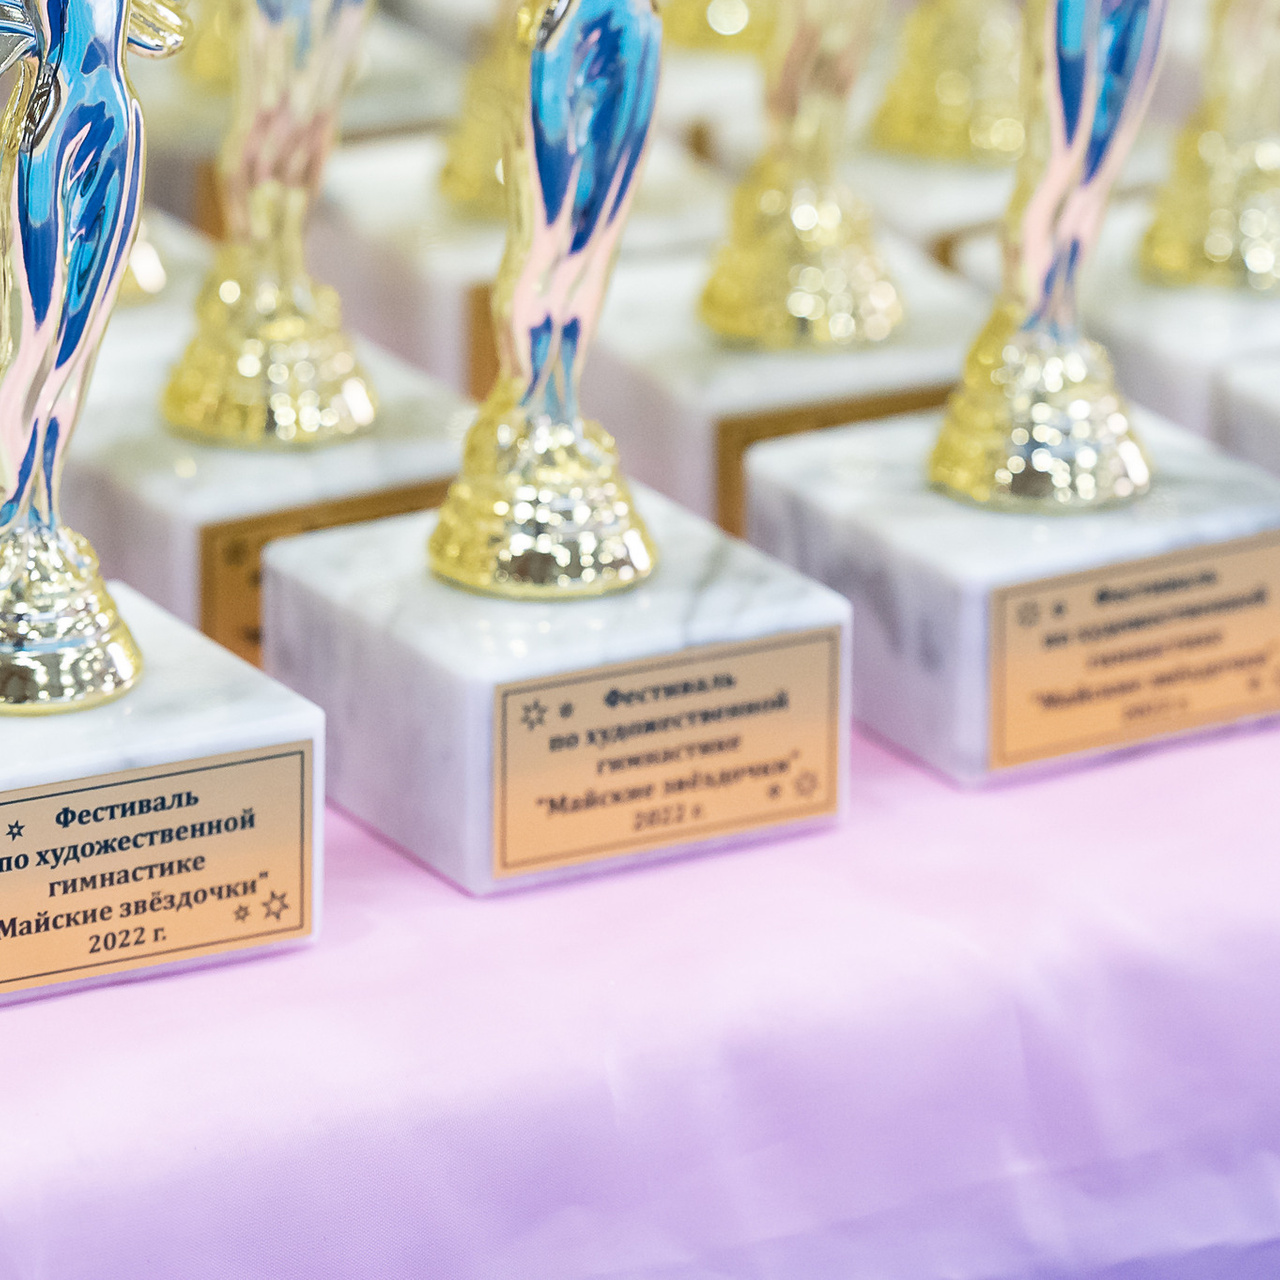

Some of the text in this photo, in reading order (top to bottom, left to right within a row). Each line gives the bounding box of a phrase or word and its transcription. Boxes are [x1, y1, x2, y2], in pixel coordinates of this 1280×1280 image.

[55, 790, 199, 829] Фестиваль
[35, 808, 255, 869] художественной
[48, 855, 206, 898] гимнастике
[119, 871, 269, 919] звёздочки"
[88, 926, 167, 954] 2022 г.
